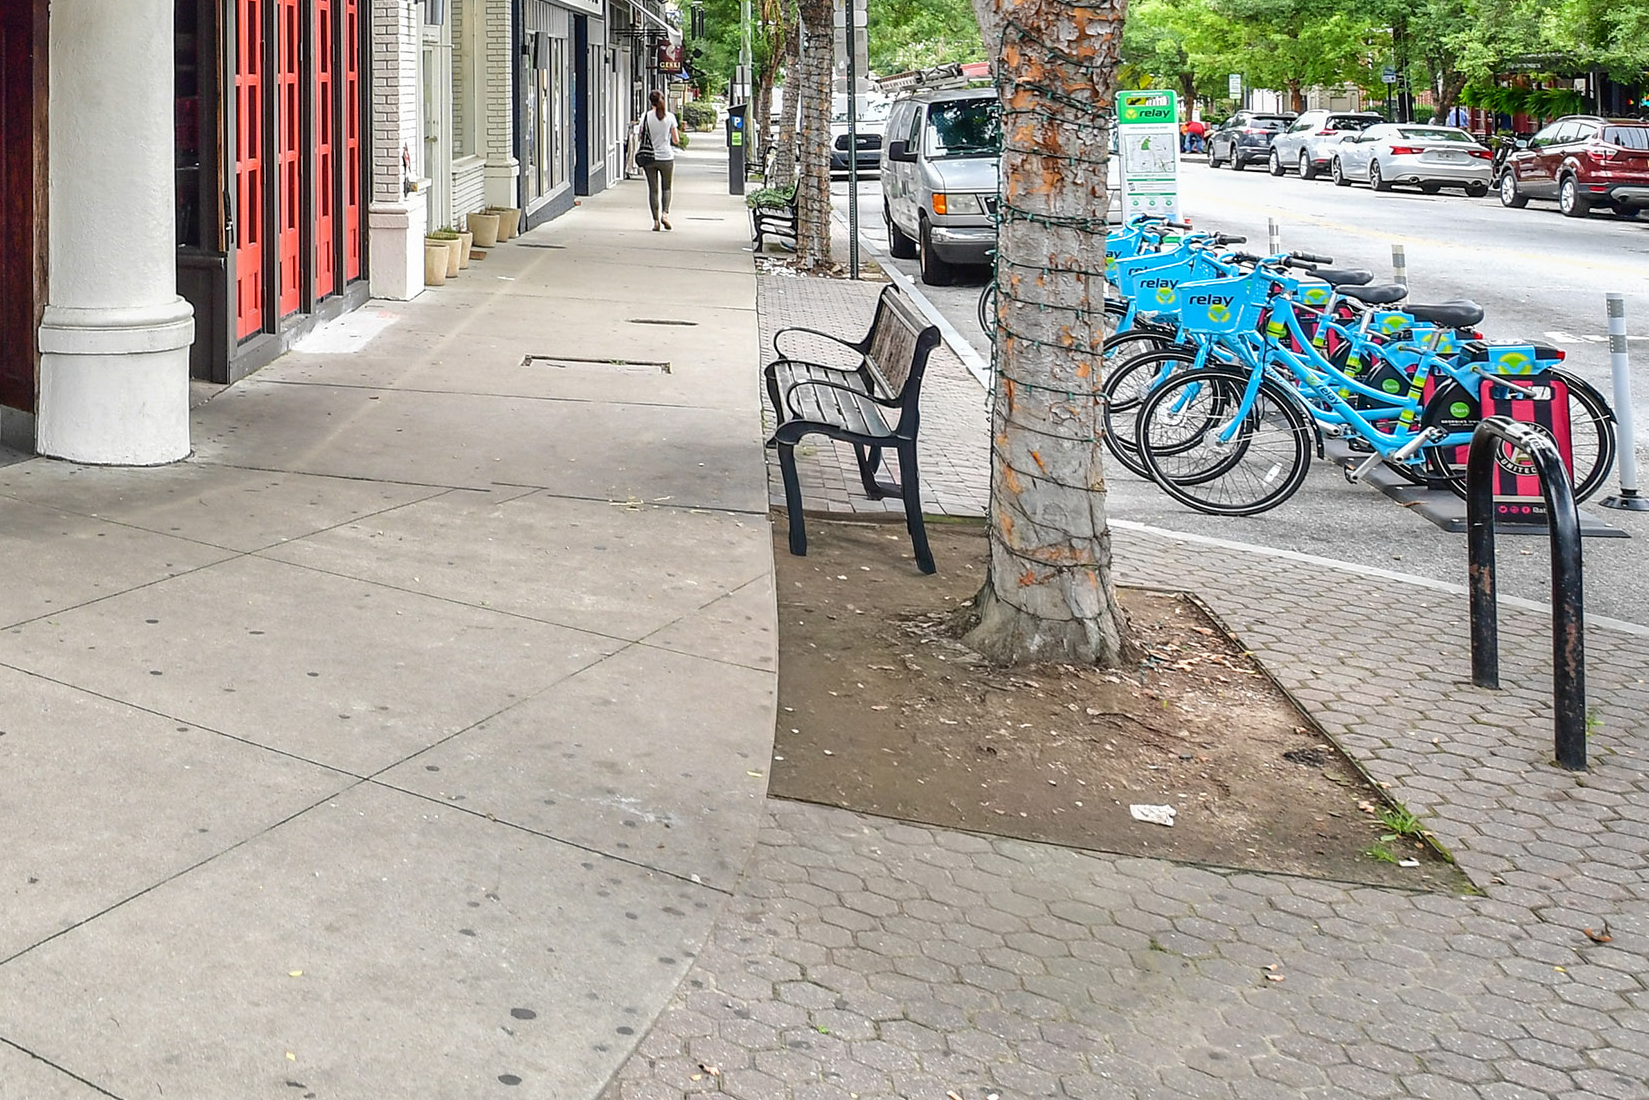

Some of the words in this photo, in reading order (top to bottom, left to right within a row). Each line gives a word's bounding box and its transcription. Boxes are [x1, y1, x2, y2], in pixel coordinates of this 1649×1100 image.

[1139, 108, 1171, 118] relay
[1140, 277, 1180, 290] relay
[1189, 293, 1235, 308] relay
[1315, 383, 1342, 406] relay
